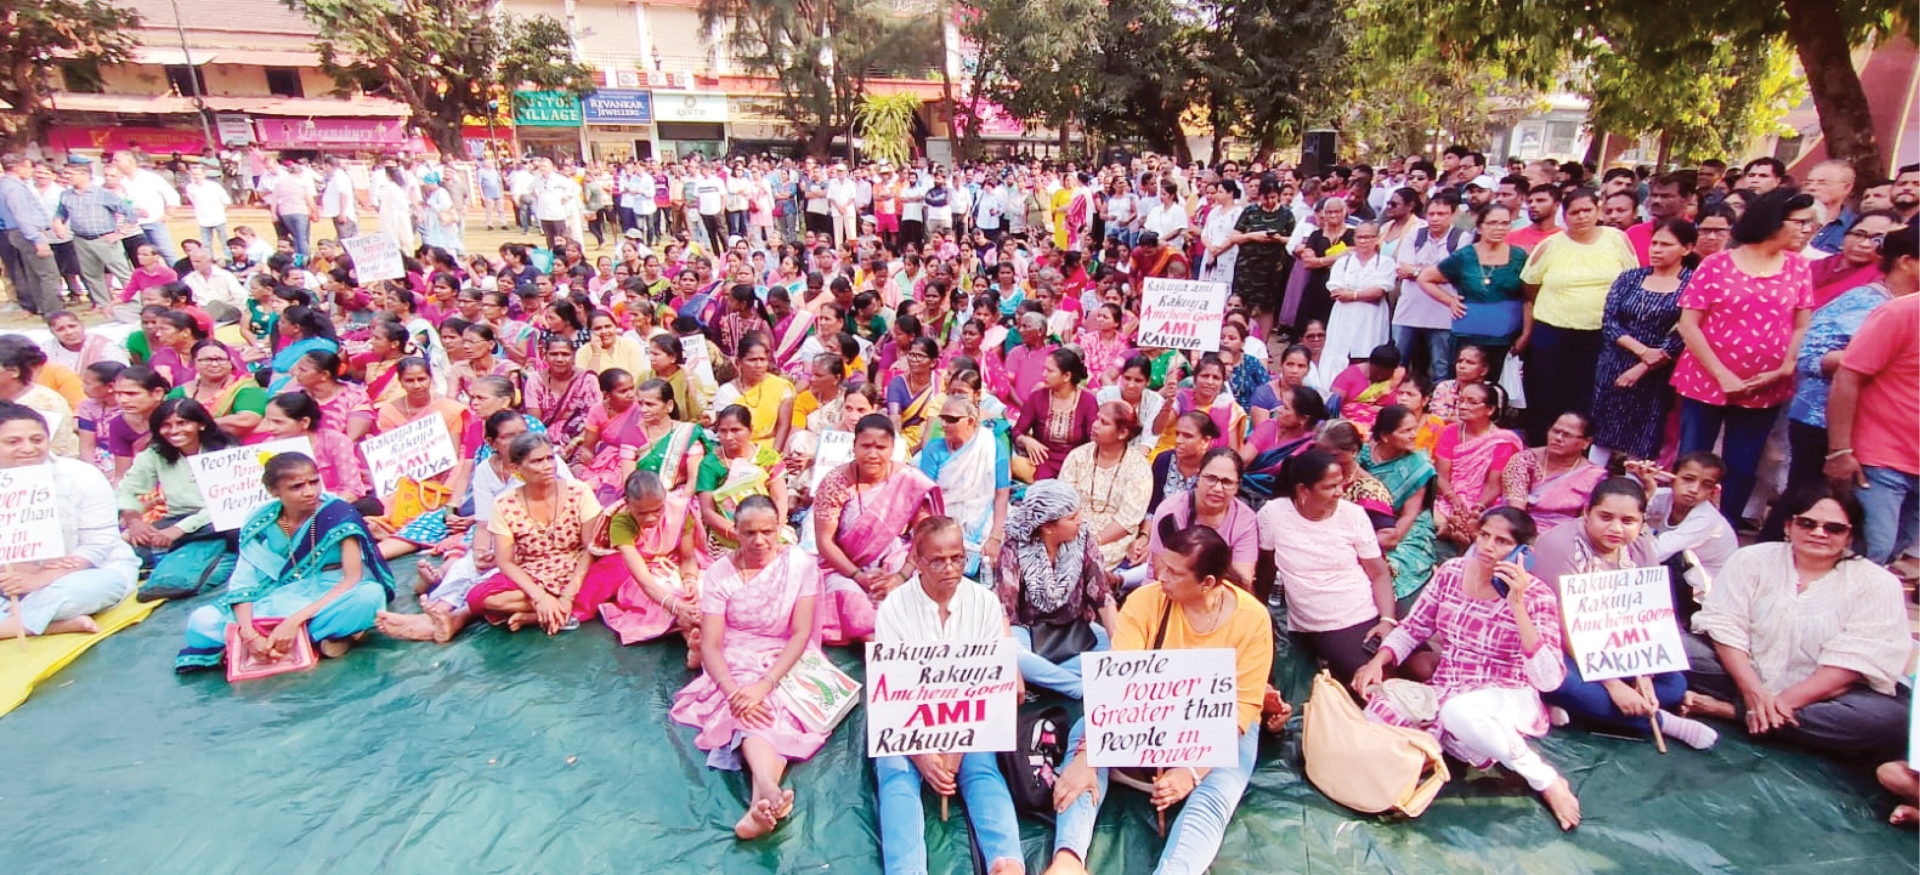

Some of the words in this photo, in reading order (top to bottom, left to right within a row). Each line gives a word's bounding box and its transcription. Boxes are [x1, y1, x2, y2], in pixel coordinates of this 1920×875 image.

[589, 98, 645, 109] REVANKAR
[598, 109, 640, 117] JEWELLERS
[1147, 281, 1189, 294] Rakuya
[1190, 284, 1214, 292] ami
[1142, 304, 1192, 321] Amchem
[1158, 294, 1210, 311] Rakuya
[1140, 331, 1202, 348] RAKUYA
[1157, 321, 1197, 337] AMI
[200, 447, 263, 471] People's
[394, 453, 429, 477] AMI
[383, 457, 451, 495] RUYA
[30, 482, 50, 504] is
[20, 507, 54, 523] than
[12, 528, 27, 543] in
[1566, 571, 1629, 595] Rakuya
[1635, 568, 1664, 586] ami
[1576, 591, 1643, 615] Rakuya
[1571, 612, 1634, 634] Amchem
[1603, 627, 1651, 650] AMI
[871, 642, 951, 666] Rakuya
[955, 640, 999, 659] ami
[1585, 643, 1672, 674] RAKUYA
[917, 665, 1003, 686] Rakuya
[1094, 653, 1169, 681] People
[871, 673, 958, 703] Amchem
[1210, 672, 1233, 694] is
[903, 699, 986, 728] AMI
[1091, 702, 1175, 728] Greater
[1183, 698, 1233, 721] than
[875, 728, 975, 755] Rakuya
[1096, 726, 1168, 756] People
[1177, 727, 1200, 744] in
